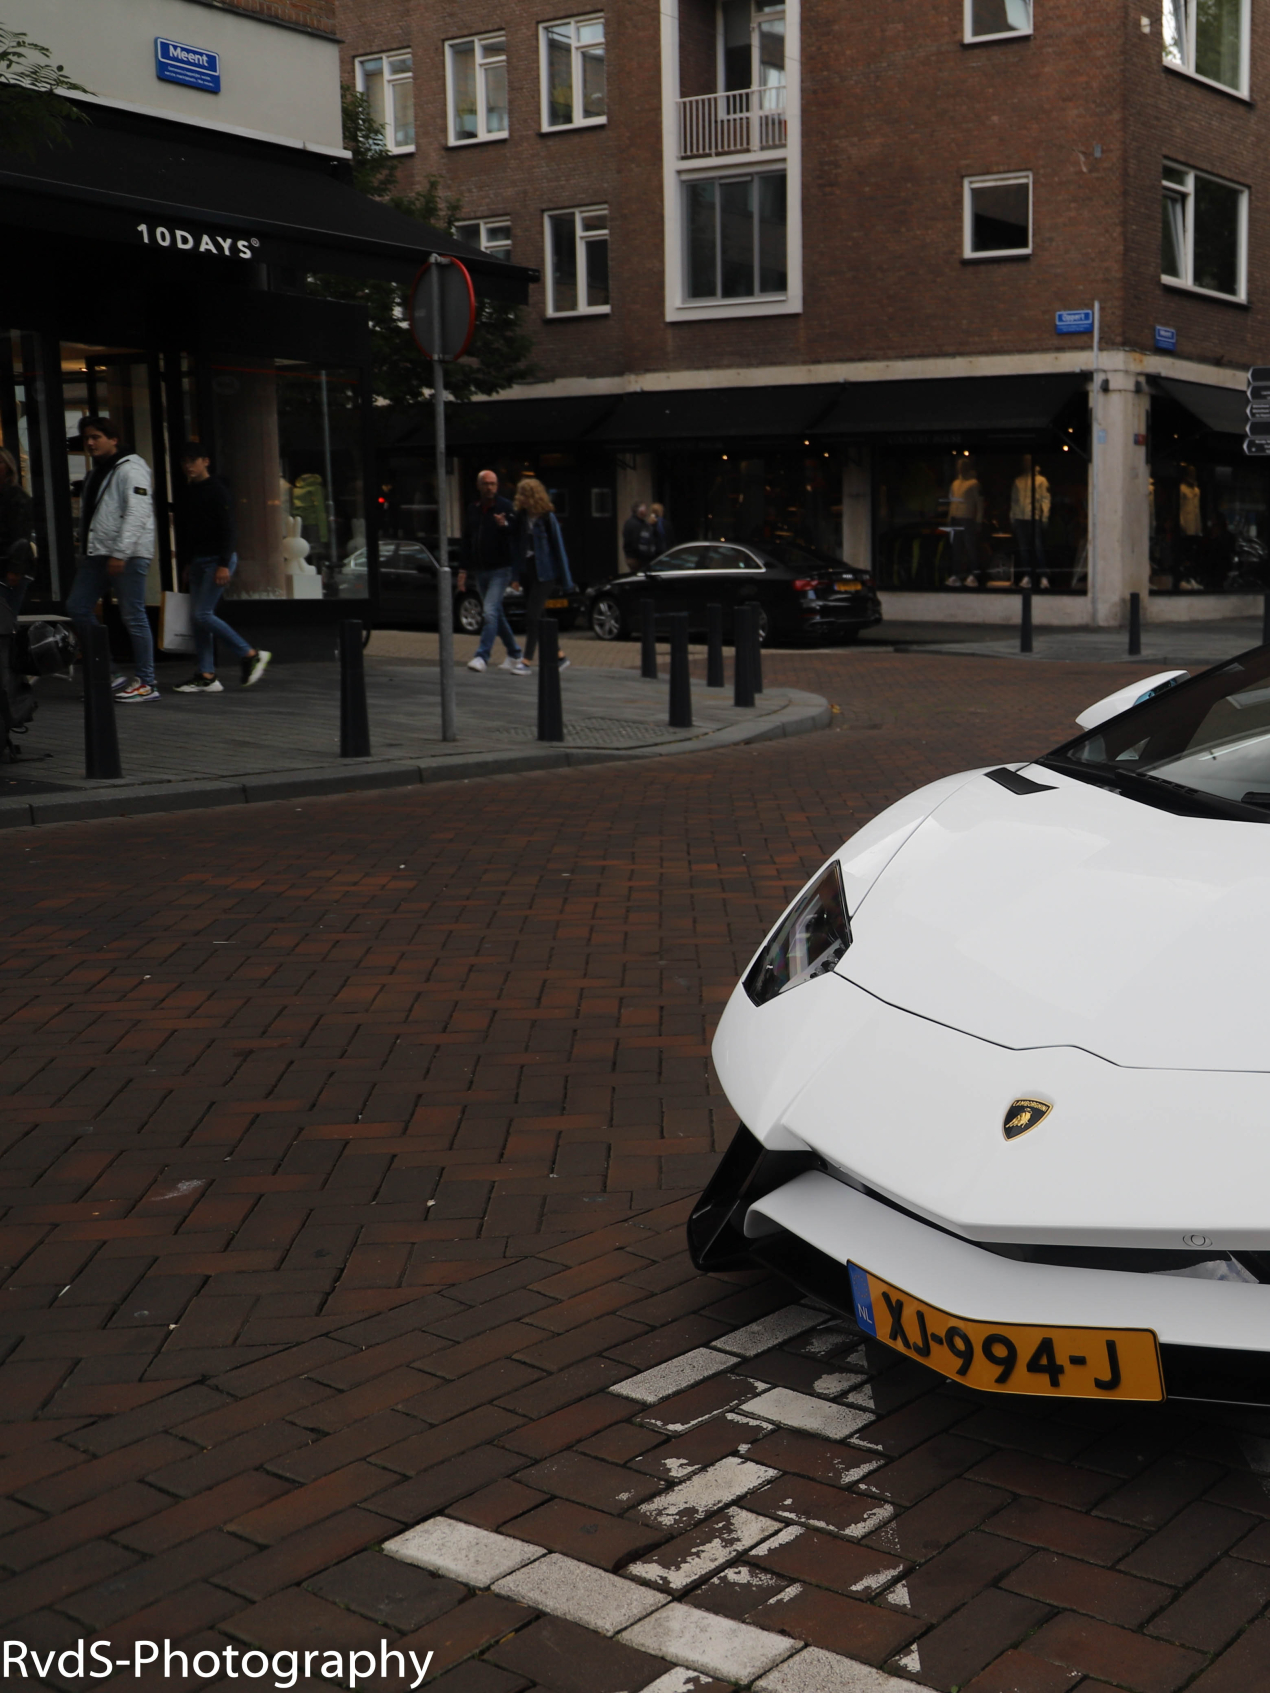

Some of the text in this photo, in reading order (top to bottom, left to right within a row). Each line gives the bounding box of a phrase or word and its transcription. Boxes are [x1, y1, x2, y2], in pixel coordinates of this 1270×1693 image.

[168, 44, 209, 67] Meent
[856, 1302, 873, 1325] NL
[881, 1290, 1122, 1391] XJ-994-J
